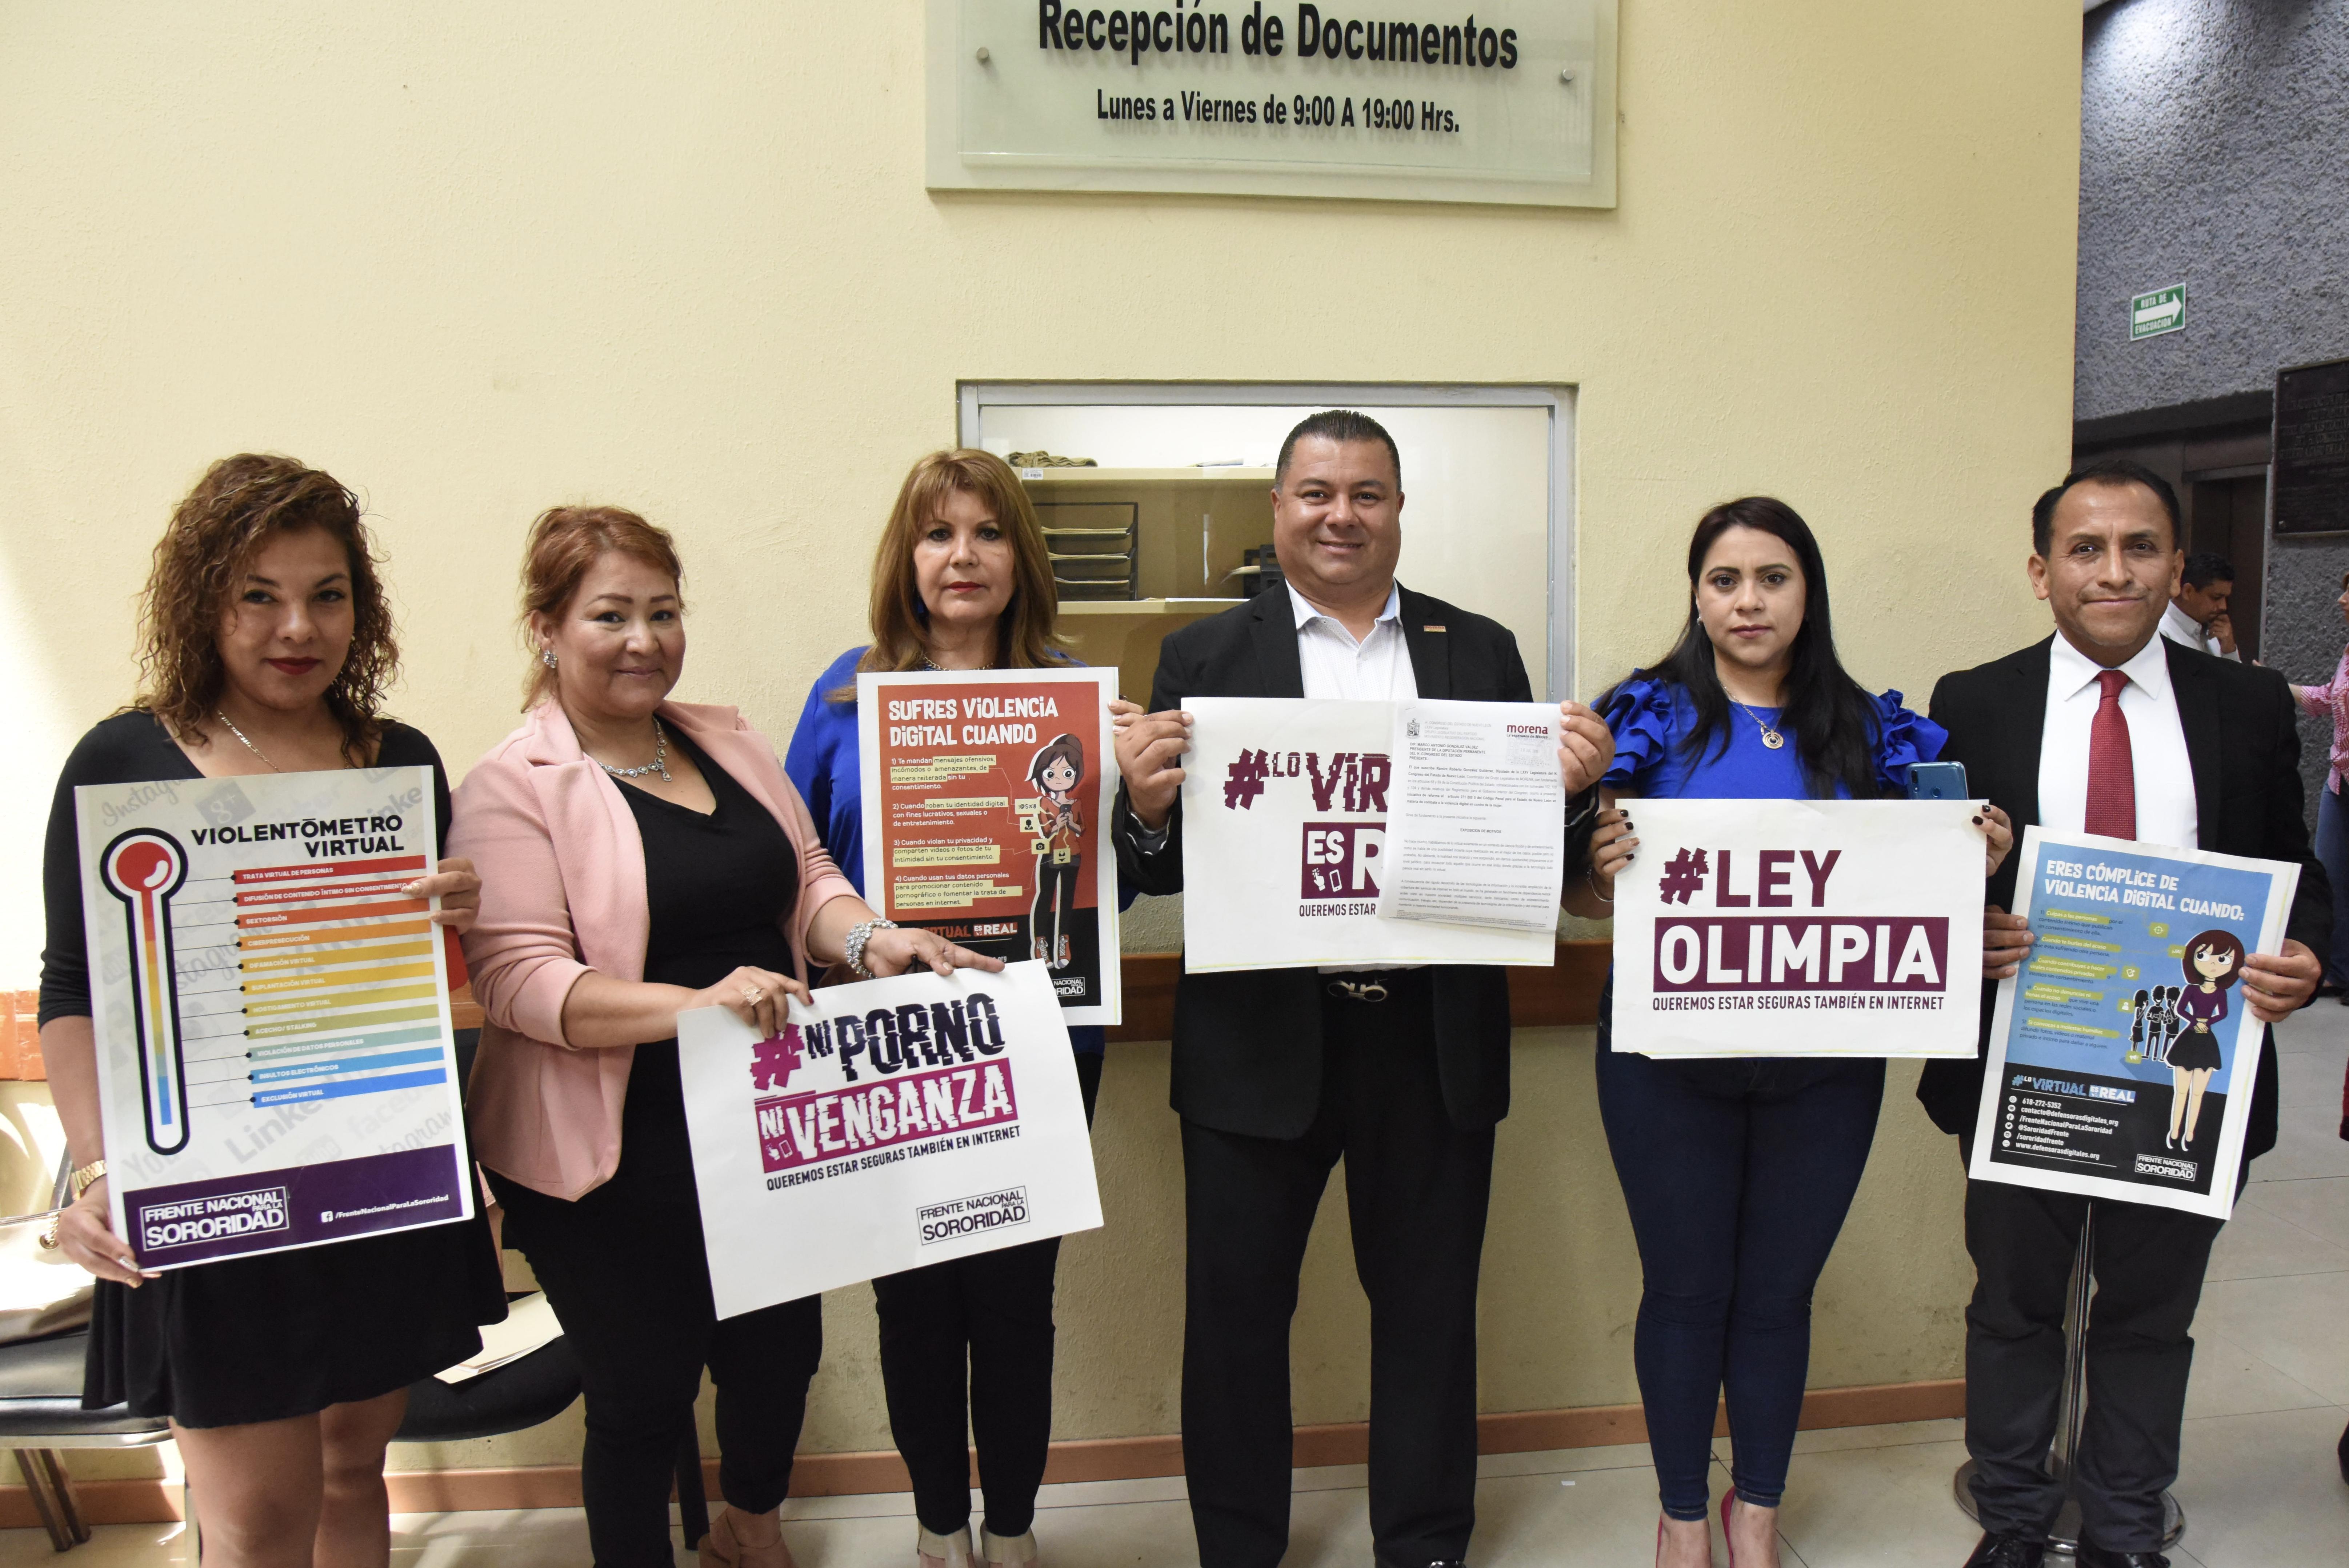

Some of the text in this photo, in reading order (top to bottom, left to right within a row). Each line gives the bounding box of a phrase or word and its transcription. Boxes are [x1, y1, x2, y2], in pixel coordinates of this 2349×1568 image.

[1039, 0, 1517, 69] Recepción de Documentos
[1097, 89, 1459, 132] Lunes a Viernes de 9:00 A 19:00 Hrs.
[2141, 293, 2167, 309] RUTA DE
[889, 699, 957, 720] SUFRES
[963, 723, 1036, 745] CUANDO
[1507, 725, 1548, 734] morena
[304, 836, 404, 857] VIRTUAL
[1307, 831, 1344, 864] ES
[1659, 847, 1841, 907] #LEY
[2046, 860, 2083, 879] ERES
[2159, 875, 2179, 891] DE
[244, 893, 273, 902] DIFUSIÓN
[246, 915, 287, 924] SEXTORSIÓN
[1300, 903, 1376, 917] QUEREMOS ESTAR
[2180, 898, 2244, 921] CUANDO:
[984, 923, 1017, 935] REAL
[1660, 924, 1940, 984] OLIMPIA
[1653, 992, 1944, 1011] QUEREMOS ESTAR SEGURAS TAMBIÉN EN INTERNET
[324, 1039, 364, 1048] PERSONALES
[835, 993, 1005, 1081] PORNO
[298, 1089, 324, 1097] VIRTUAL
[2099, 1087, 2134, 1102] REAL
[760, 1064, 1013, 1160] NI VENGANZA
[2022, 1098, 2061, 1109] 618-272-5352
[2018, 1124, 2069, 1137] @SororidadFrente
[2020, 1115, 2112, 1135] /FrenteNacionalParaLaSororidad
[2017, 1133, 2064, 1145] /sororidadfrente
[767, 1126, 1020, 1191] QUEREMOS ESTAR SEGURAS TAMBIÉN EN INTERNET
[2016, 1142, 2100, 1160] www.defensorasdigitales.org
[2137, 1163, 2193, 1179] SORORIDAD
[2163, 1160, 2194, 1169] NACIONAL
[145, 1191, 283, 1222] FRENTE NACIONAL
[921, 1190, 1023, 1220] FRENTE NACIONAL
[148, 1208, 284, 1247] SORORIDAD
[923, 1206, 1025, 1240] SORORIDAD
